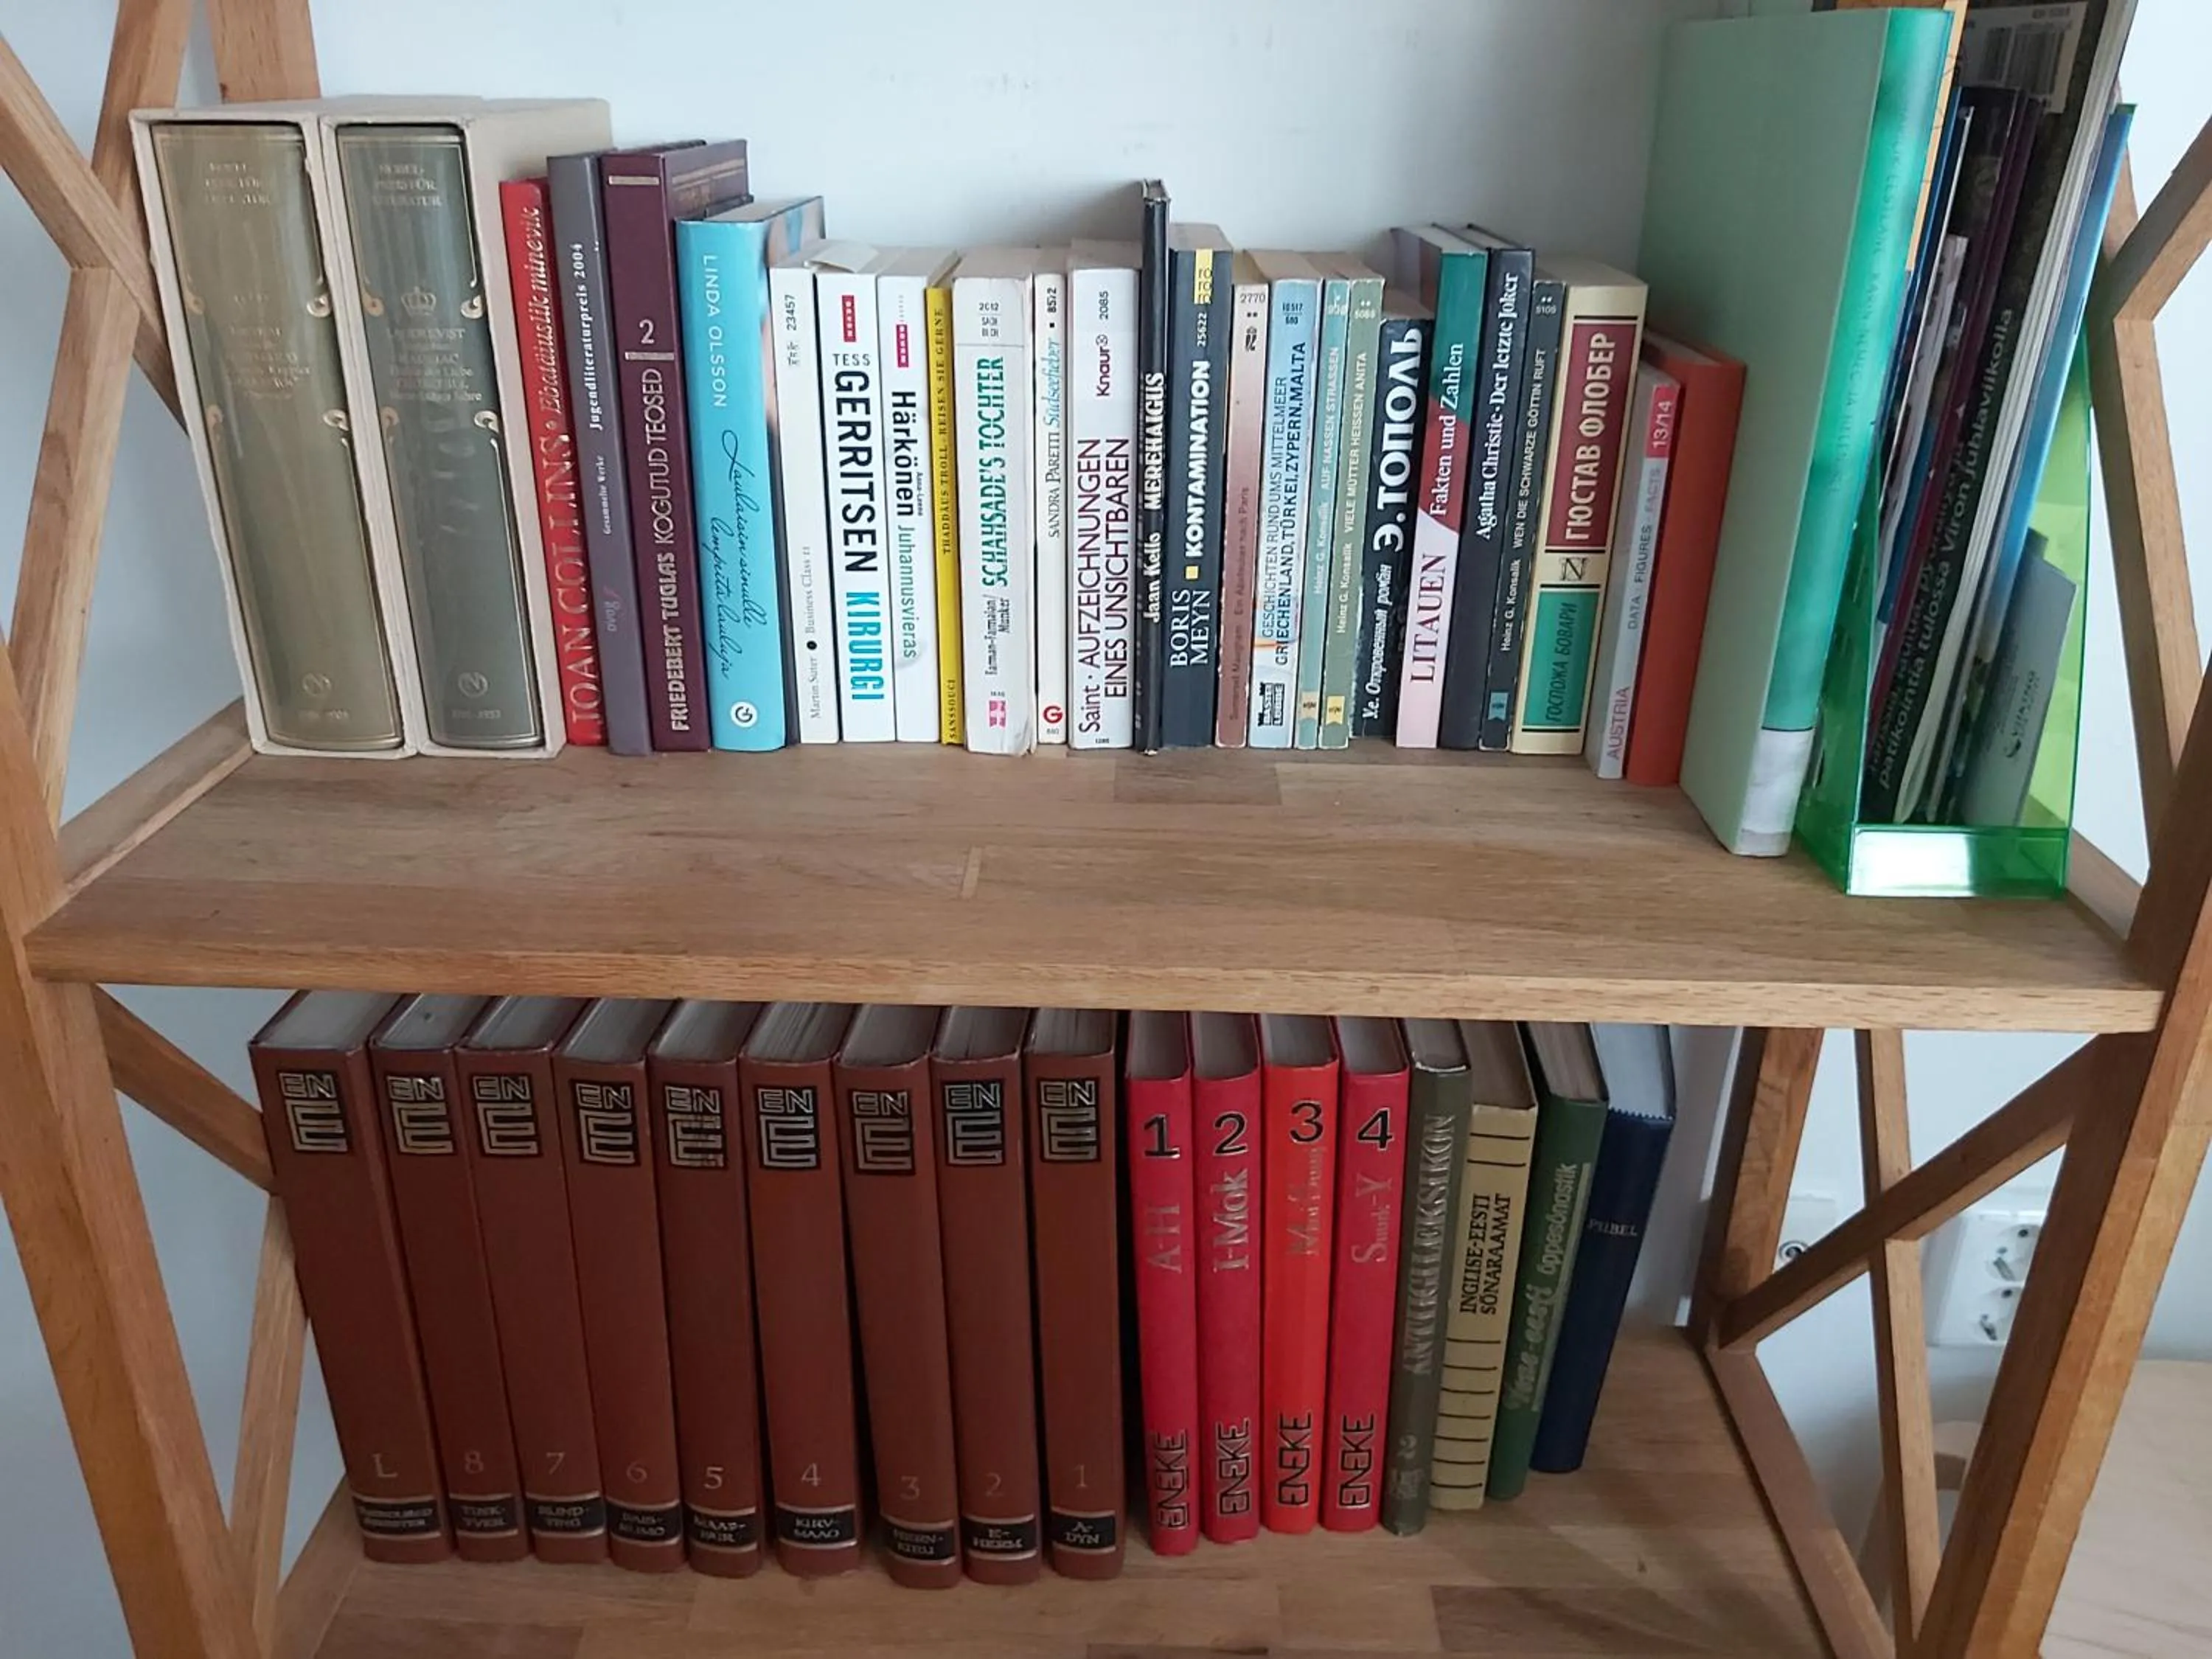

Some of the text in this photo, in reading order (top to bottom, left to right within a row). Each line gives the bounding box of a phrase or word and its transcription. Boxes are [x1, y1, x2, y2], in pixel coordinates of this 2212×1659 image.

[570, 243, 586, 279] 2004
[785, 294, 797, 330] 23457
[1099, 291, 1109, 321] 2085
[1498, 272, 1519, 319] Joker
[575, 285, 603, 431] Jugendliteraturpreis
[639, 319, 655, 344] 2
[703, 254, 727, 407] LINDA OLSSON
[832, 353, 871, 366] TESS
[933, 307, 944, 355] GERNE
[1492, 322, 1514, 370] letzte
[936, 361, 945, 381] SIE
[1326, 347, 1339, 412] STRASSEN
[1489, 374, 1508, 406] Der
[936, 387, 947, 435] REISEN
[977, 357, 1006, 451] TOCHTER
[1185, 311, 1211, 558] KONTAMINATION 25622
[1565, 333, 1615, 540] ГЮСТАВ ФЛОБЕР
[834, 370, 879, 572] GERRITSEN
[939, 445, 949, 485] TROLL
[1322, 414, 1335, 464] NASSEN
[1143, 372, 1165, 623] Jaan Kello MEREHAIGUS
[1262, 377, 1287, 638] GESCHICHTEN RUND UMS MITTELMEER
[1321, 466, 1332, 490] AUF
[1336, 352, 1367, 634] Heinz G. Konsalik VIELE MÜTTER HEISSEN ANITA
[1475, 481, 1498, 540] Agatha
[1500, 347, 1547, 652] Heinz G. Konsalik WEN DIE SCHWARZE GÖTTIN RUFT
[1915, 561, 1951, 652] tulossa
[1941, 481, 1973, 553] Viron
[1961, 307, 2014, 478] juhlaviikolla
[543, 434, 588, 614] COLLINS
[891, 392, 919, 658] Härkönen Juhannusvieras
[1048, 487, 1060, 538] SANDRA
[1096, 345, 1130, 698] EINES UNSICHTBAREN Knaur
[1411, 342, 1464, 683] LITAUEN Fakten und Zahlen
[642, 368, 690, 731] FRIEDEBERT TUGLAS KOGUTUD TEOSED
[799, 559, 812, 588] Class
[1606, 400, 1672, 761] AUSTRIA DATA FIGURES FACTS 13/14
[804, 591, 815, 634] Business
[1077, 439, 1101, 734] Saint AUFZEICHNUNGEN
[846, 591, 885, 700] KIRURGI
[1169, 589, 1191, 667] BORIS
[1189, 590, 1211, 665] MEYN
[1365, 608, 1388, 695] Откровенный
[562, 625, 602, 726] JOAN
[1545, 602, 1578, 723] ГОСПОЖА БОВАРИ
[809, 685, 822, 720] Martin
[1142, 1113, 1180, 1159] 1
[1212, 1110, 1248, 1157] 2
[1287, 1098, 1324, 1144] 3
[1356, 1106, 1394, 1152] 4
[1538, 1161, 1578, 1276] õppesõnastik
[1458, 1192, 1490, 1315] INGLISE-EESTI
[1480, 1192, 1511, 1316] SÕNARAAMAT
[465, 1450, 484, 1474] 8
[546, 1451, 566, 1475] 7
[626, 1461, 647, 1484] 6
[703, 1466, 725, 1489] 5
[801, 1463, 822, 1487] 4
[900, 1475, 921, 1500] 3
[985, 1472, 1004, 1498] 2
[1075, 1464, 1088, 1489] 1
[1155, 1430, 1189, 1530] ENEKE
[1217, 1416, 1251, 1515] ENEKE
[1277, 1409, 1312, 1506] ENEKE
[1336, 1413, 1374, 1509] ENEKE
